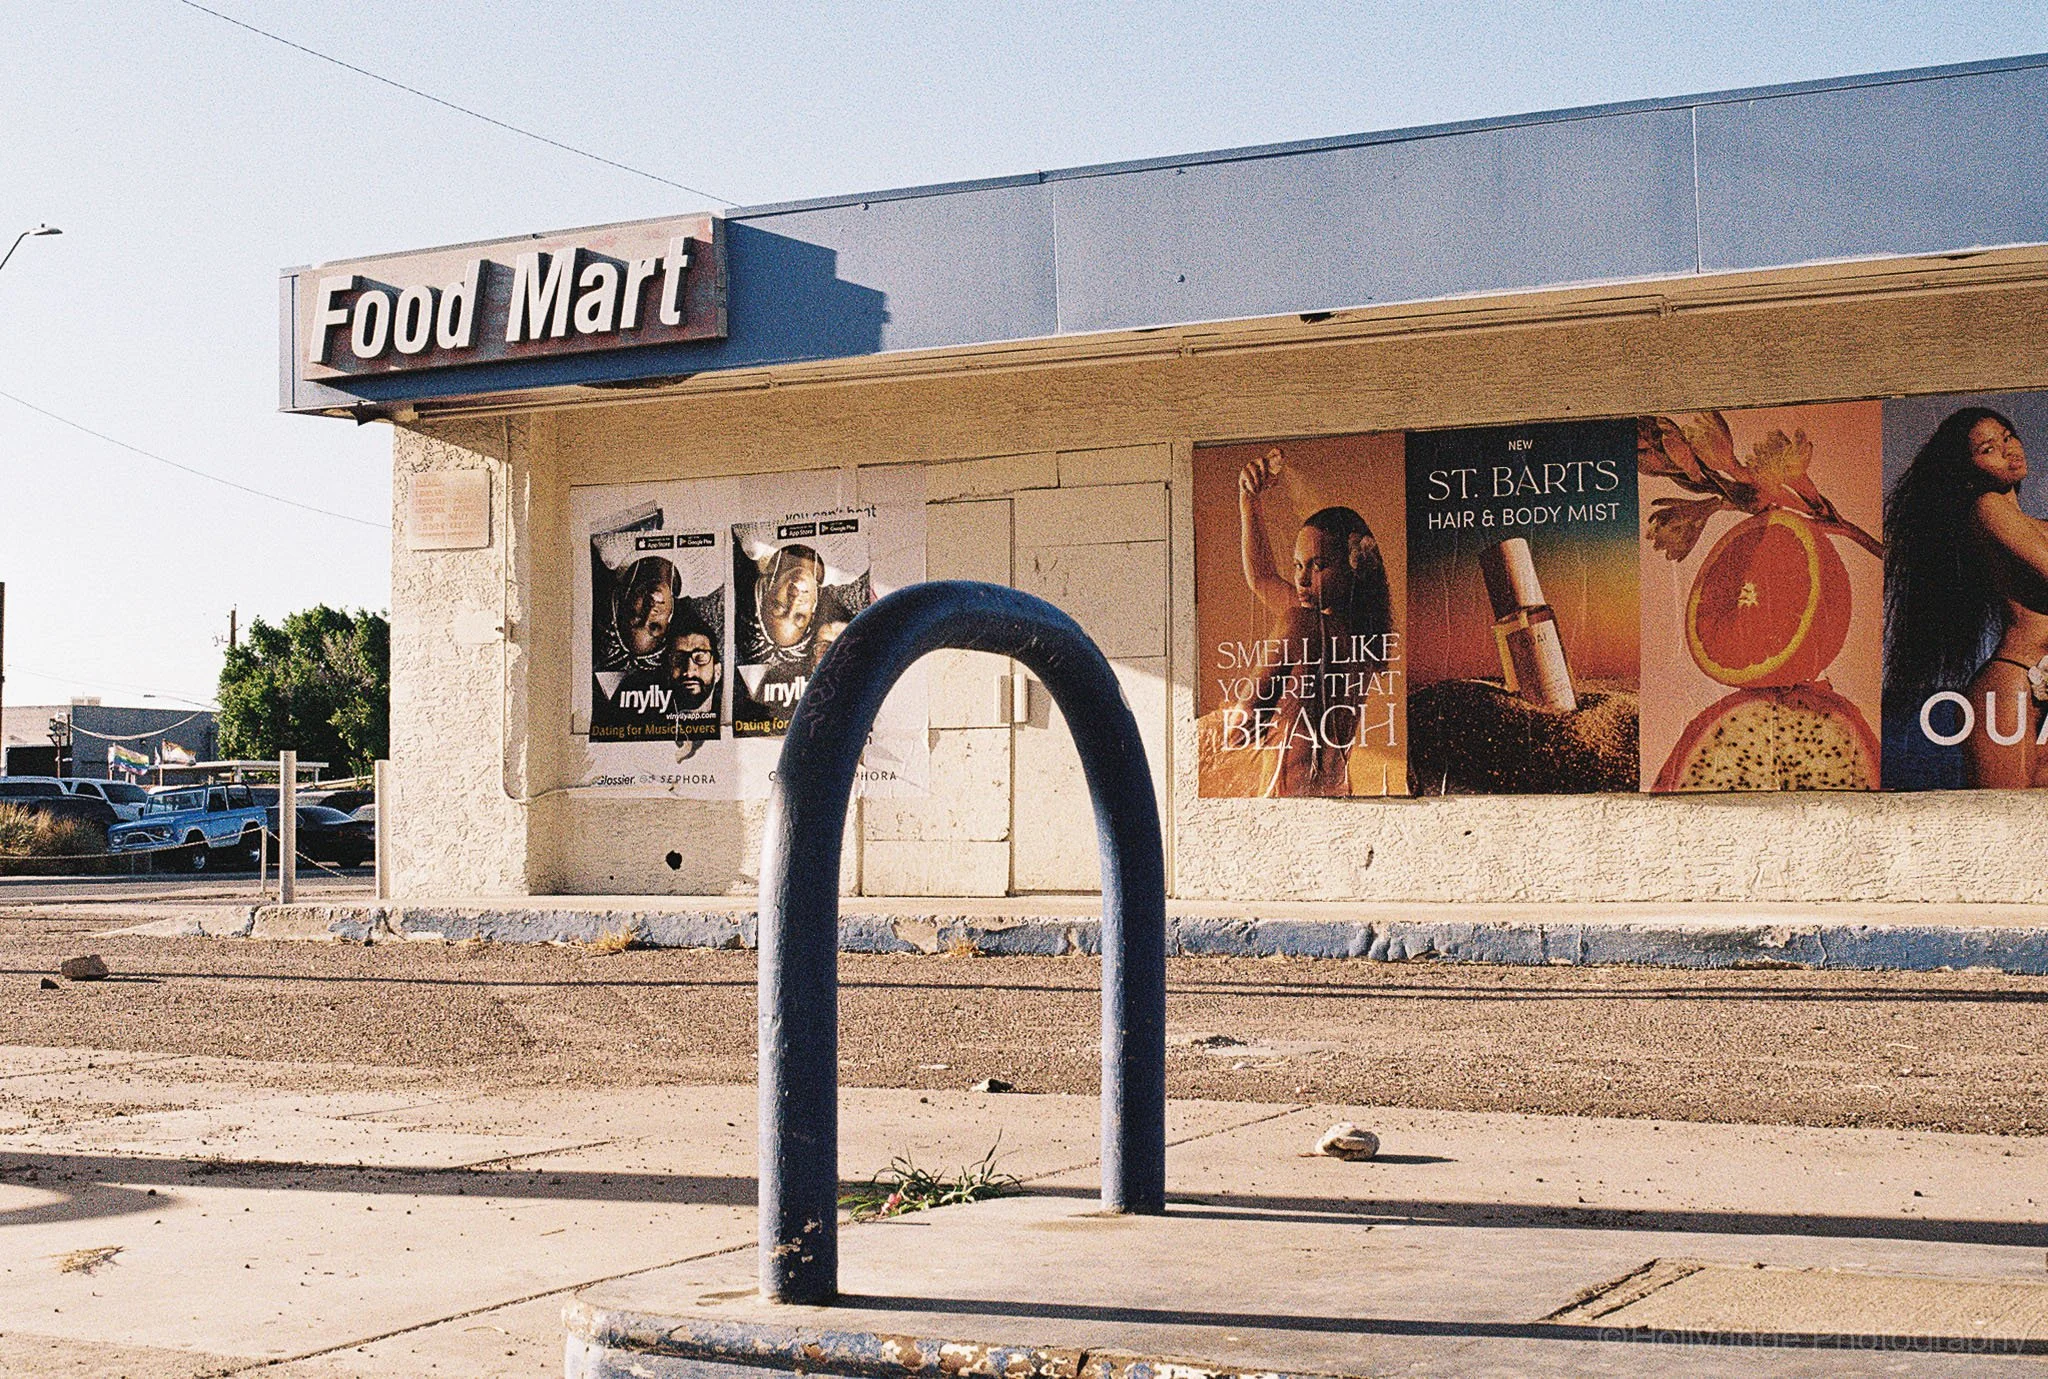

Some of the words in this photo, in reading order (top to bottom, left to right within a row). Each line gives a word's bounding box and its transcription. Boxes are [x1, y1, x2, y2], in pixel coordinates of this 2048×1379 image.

[309, 258, 488, 364] Food
[506, 236, 692, 342] Mart
[1508, 440, 1534, 451] NEW
[1428, 468, 1478, 501] ST.
[1492, 460, 1620, 497] BARTS
[1428, 510, 1475, 529] HAIR
[1481, 509, 1495, 527] &
[1502, 506, 1561, 526] BODY
[1567, 502, 1620, 522] MIST
[1217, 637, 1322, 670] SMELL
[1331, 633, 1401, 663] LIKE
[1217, 674, 1316, 702] YOU'RE
[1324, 670, 1401, 698] THAT
[591, 725, 625, 738] Dating
[627, 724, 642, 735] for
[645, 724, 676, 735] Music
[679, 724, 716, 735] Lovers
[735, 719, 771, 732] Dating
[772, 717, 788, 729] for
[1221, 702, 1398, 751] BEACH
[660, 774, 716, 784] SEPHORA
